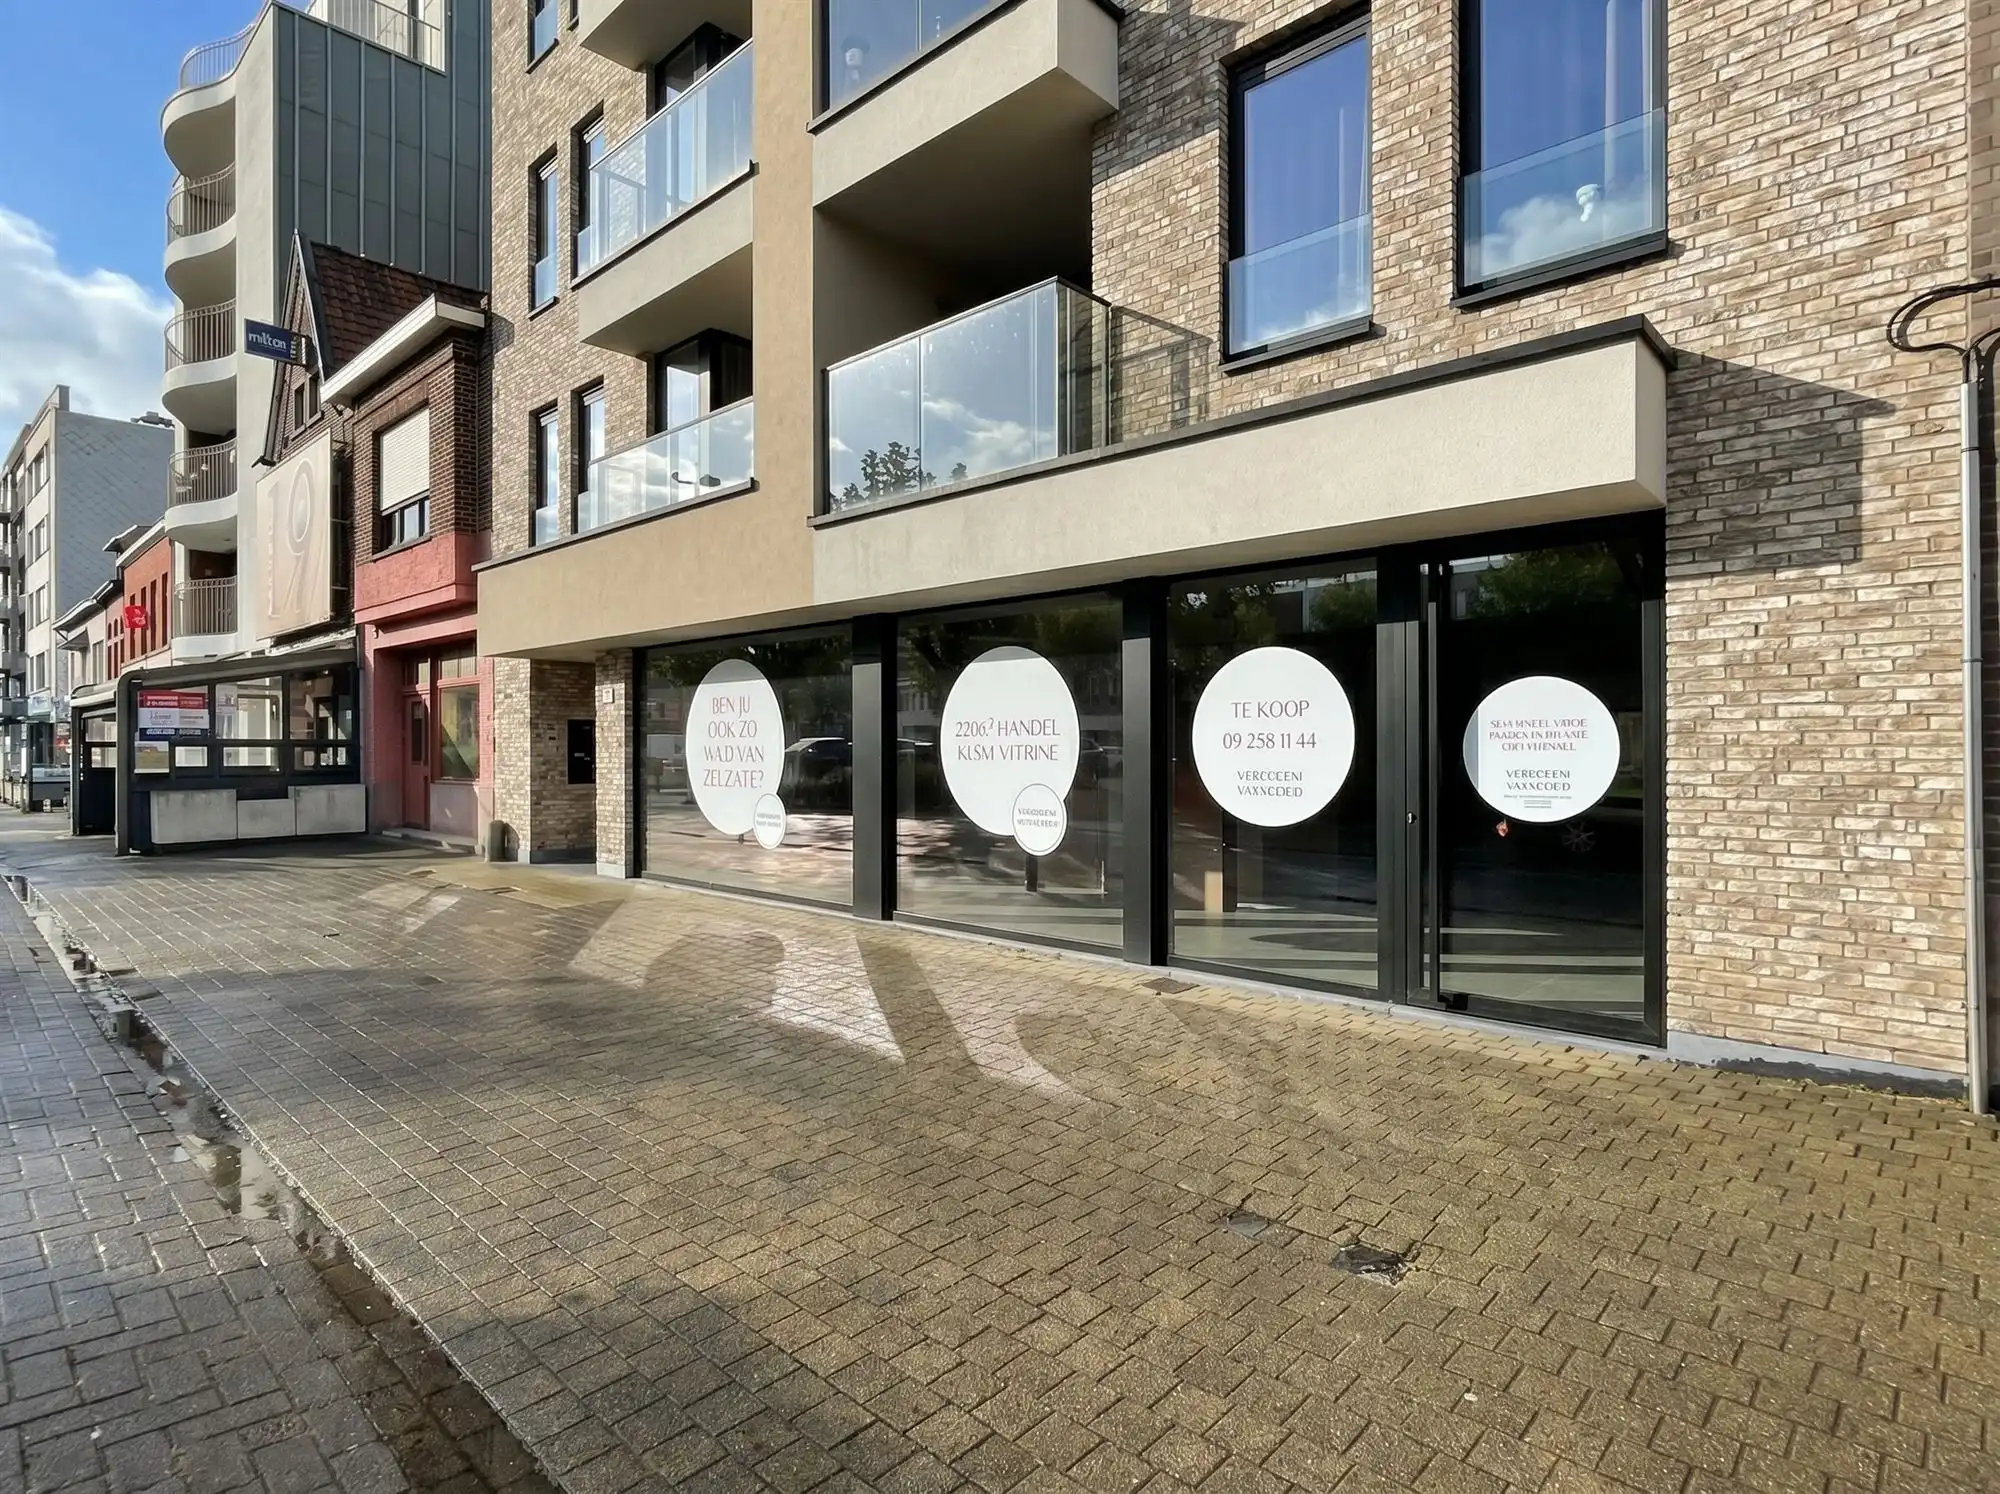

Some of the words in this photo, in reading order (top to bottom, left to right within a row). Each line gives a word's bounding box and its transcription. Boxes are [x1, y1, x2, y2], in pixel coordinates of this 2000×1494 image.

[248, 331, 287, 351] milton
[712, 696, 735, 715] BEN
[738, 694, 751, 719] JU
[1231, 701, 1252, 719] TE
[1257, 699, 1310, 718] KOOP
[708, 720, 736, 738] OOK
[739, 719, 758, 738] ZO
[997, 718, 1061, 737] HANDEL
[1222, 732, 1242, 750] 09
[1246, 732, 1276, 749] 258
[1280, 732, 1292, 749] 11
[1295, 731, 1317, 749] 44
[703, 745, 735, 763] WAD
[736, 744, 765, 763] VAN
[999, 744, 1059, 761] VITRINE
[703, 768, 766, 789] ZELZATE?
